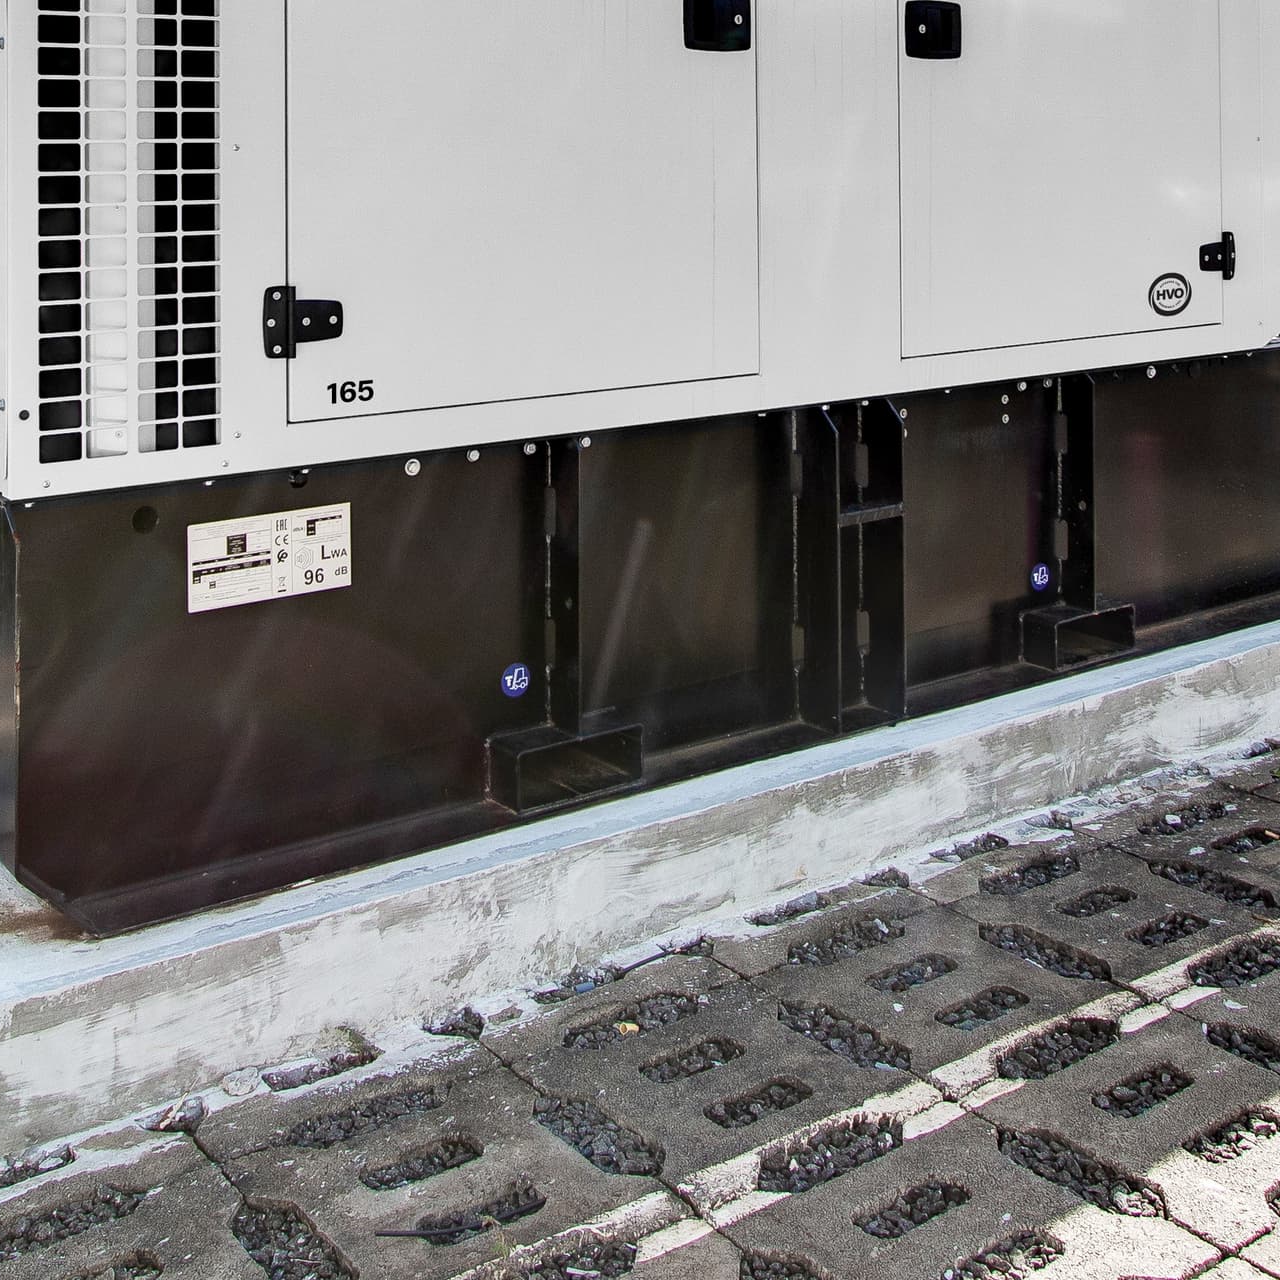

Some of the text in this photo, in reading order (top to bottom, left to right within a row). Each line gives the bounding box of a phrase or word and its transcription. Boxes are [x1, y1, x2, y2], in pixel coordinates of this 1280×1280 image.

[1156, 288, 1184, 301] HVO
[327, 380, 374, 404] 165
[304, 566, 348, 585] 96 dB
